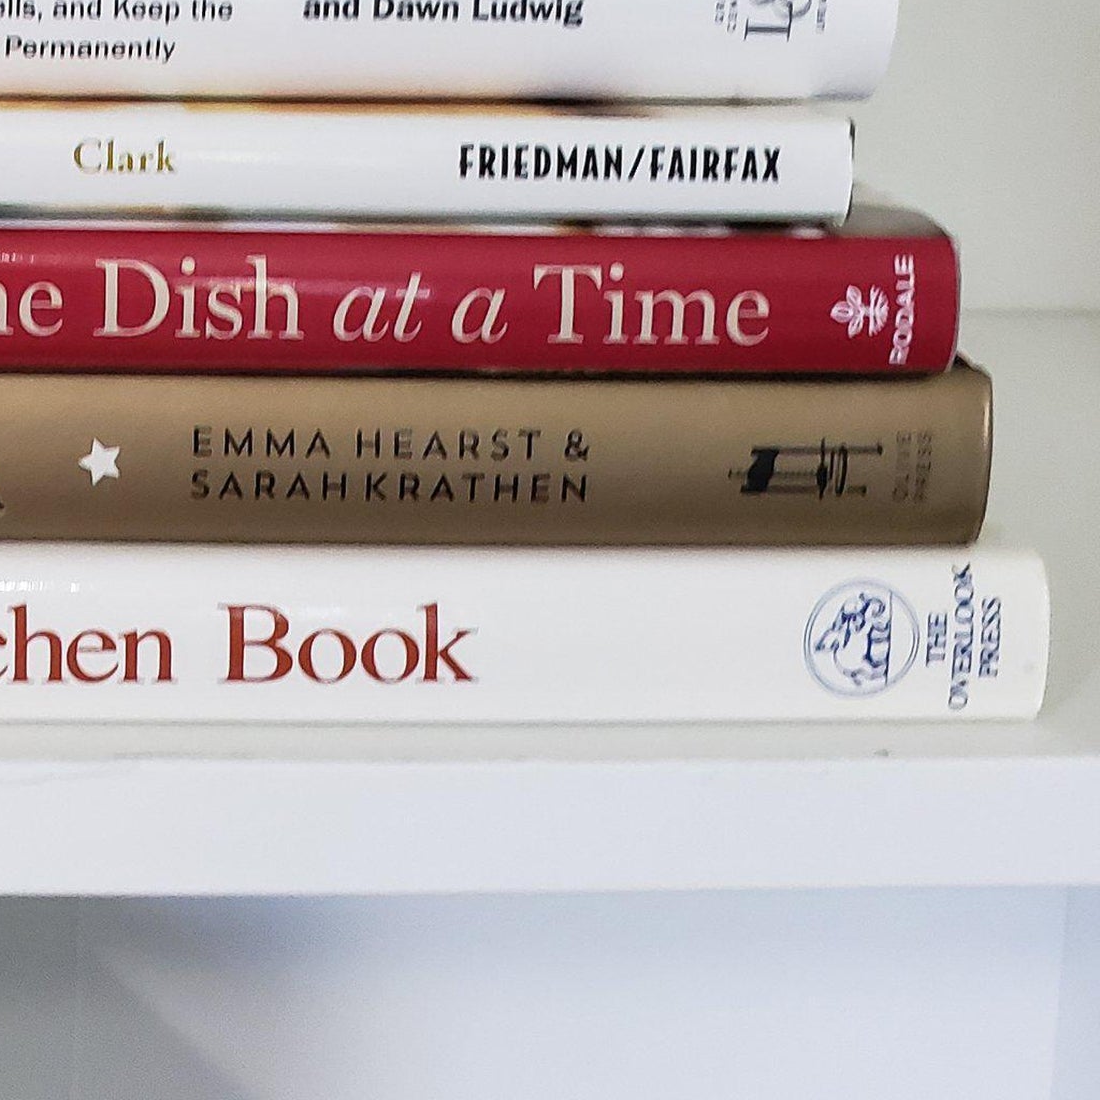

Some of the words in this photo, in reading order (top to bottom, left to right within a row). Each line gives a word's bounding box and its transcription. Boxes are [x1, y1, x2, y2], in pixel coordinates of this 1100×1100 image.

[5, 35, 175, 63] Permanently
[73, 138, 177, 174] Clark
[459, 144, 782, 183] FRIEDMAN/FAIRFAX
[95, 255, 303, 341] Dish
[333, 272, 430, 344] at
[451, 287, 508, 345] a
[534, 263, 770, 346] Time
[889, 254, 914, 365] RODALE
[192, 425, 332, 460] EMMA
[356, 428, 542, 462] HEARST
[564, 429, 590, 462] &
[190, 469, 347, 501] SARAH
[365, 471, 588, 502] KRATHEN
[216, 601, 479, 686] Book
[925, 611, 947, 667] THE
[949, 562, 975, 710] OVERLOOK
[978, 596, 1001, 678] PRESS
